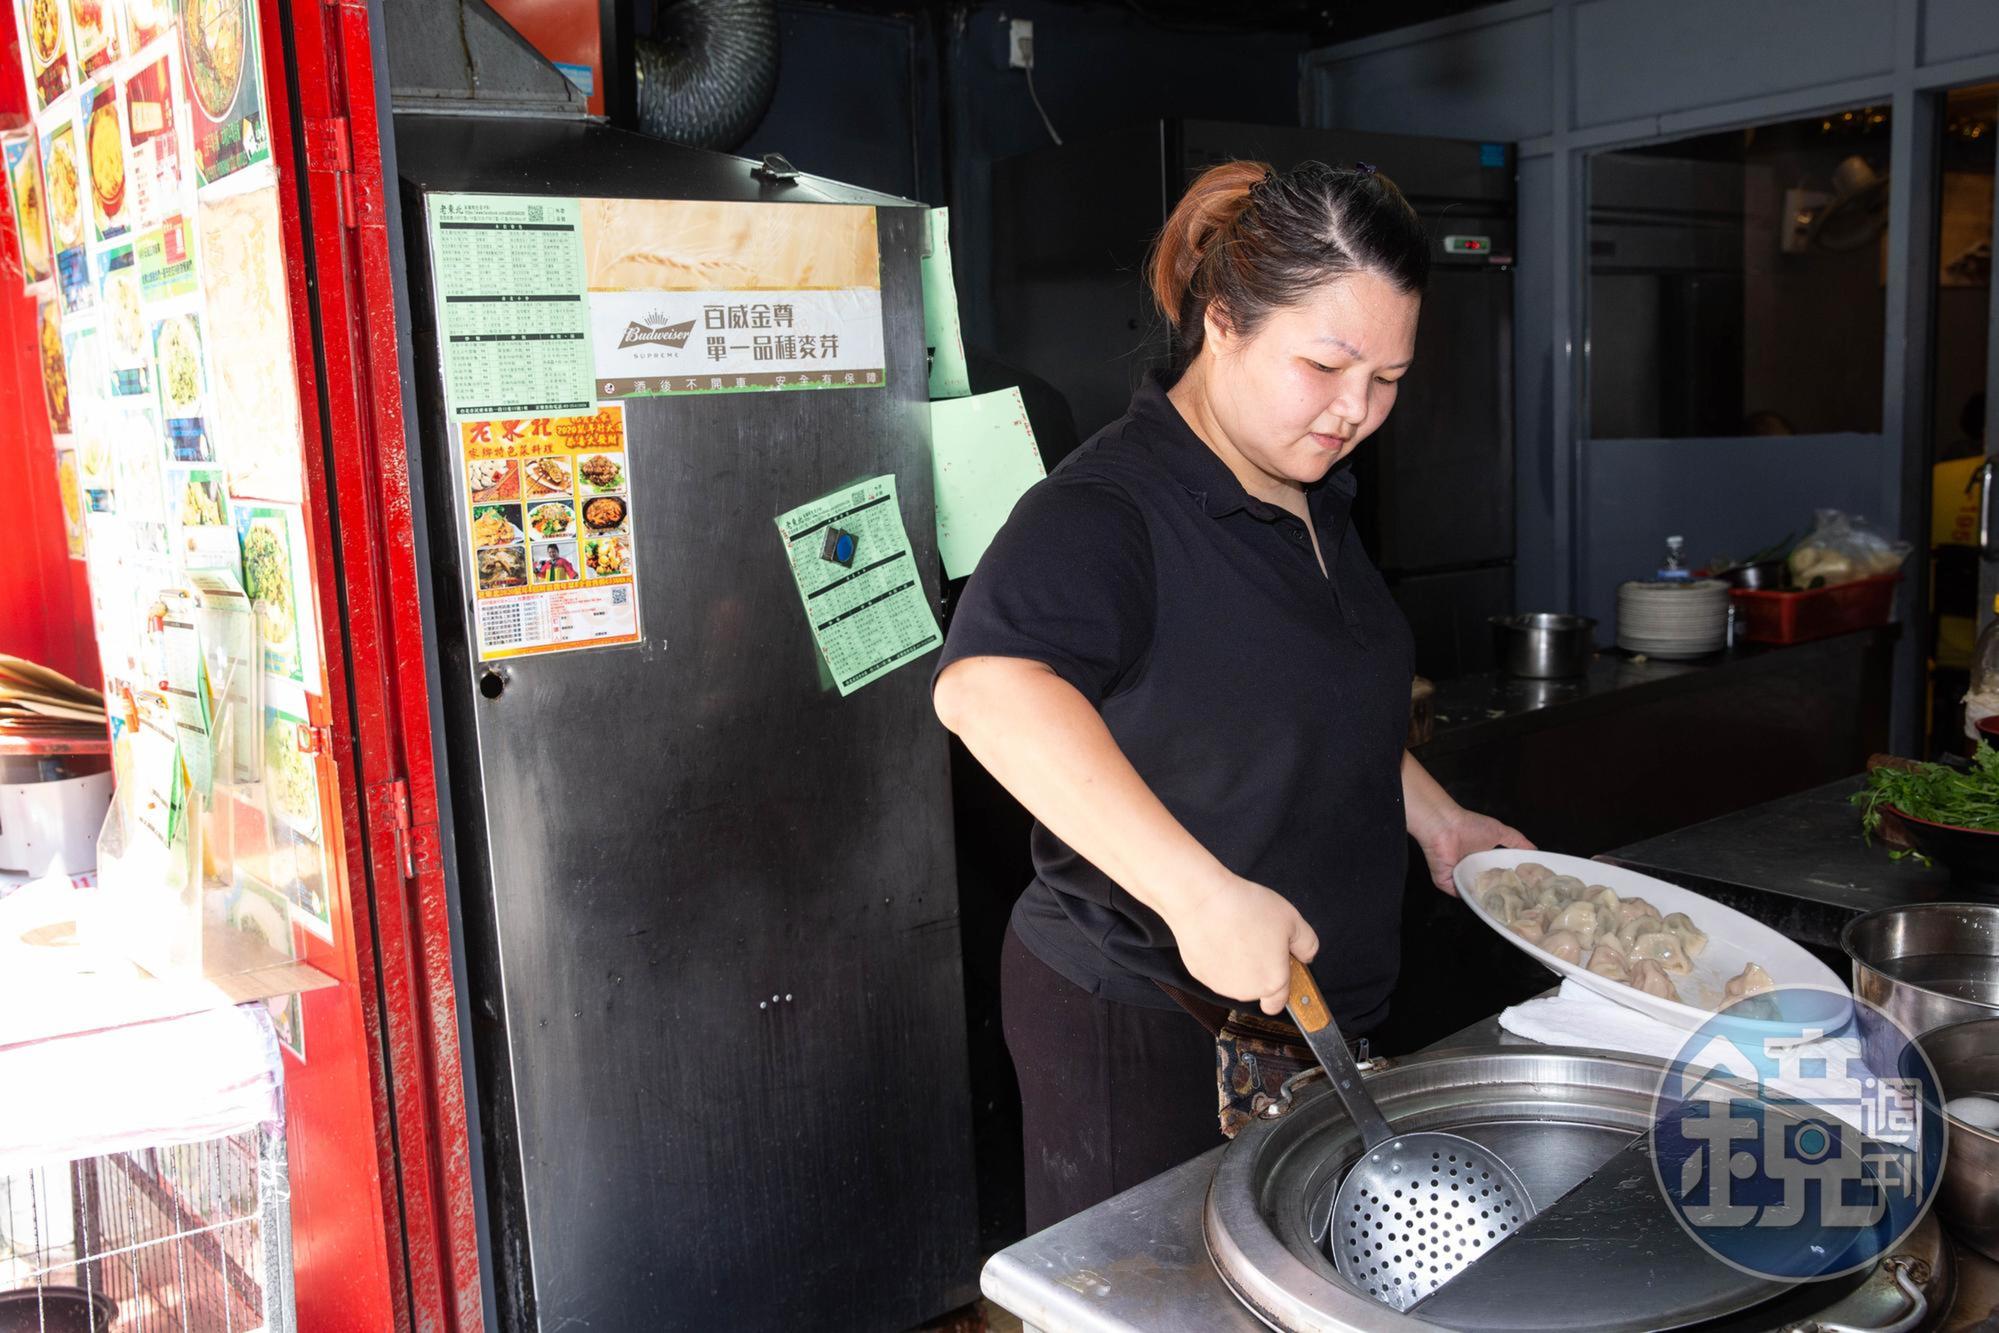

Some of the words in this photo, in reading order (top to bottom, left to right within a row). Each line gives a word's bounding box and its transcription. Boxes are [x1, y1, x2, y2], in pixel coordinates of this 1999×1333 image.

[703, 304, 794, 330] 百威金尊
[624, 325, 691, 343] Budweiser
[706, 334, 840, 362] 單一品種麥芽
[633, 377, 747, 393] 酒後不開車
[775, 373, 878, 387] 安全有保障
